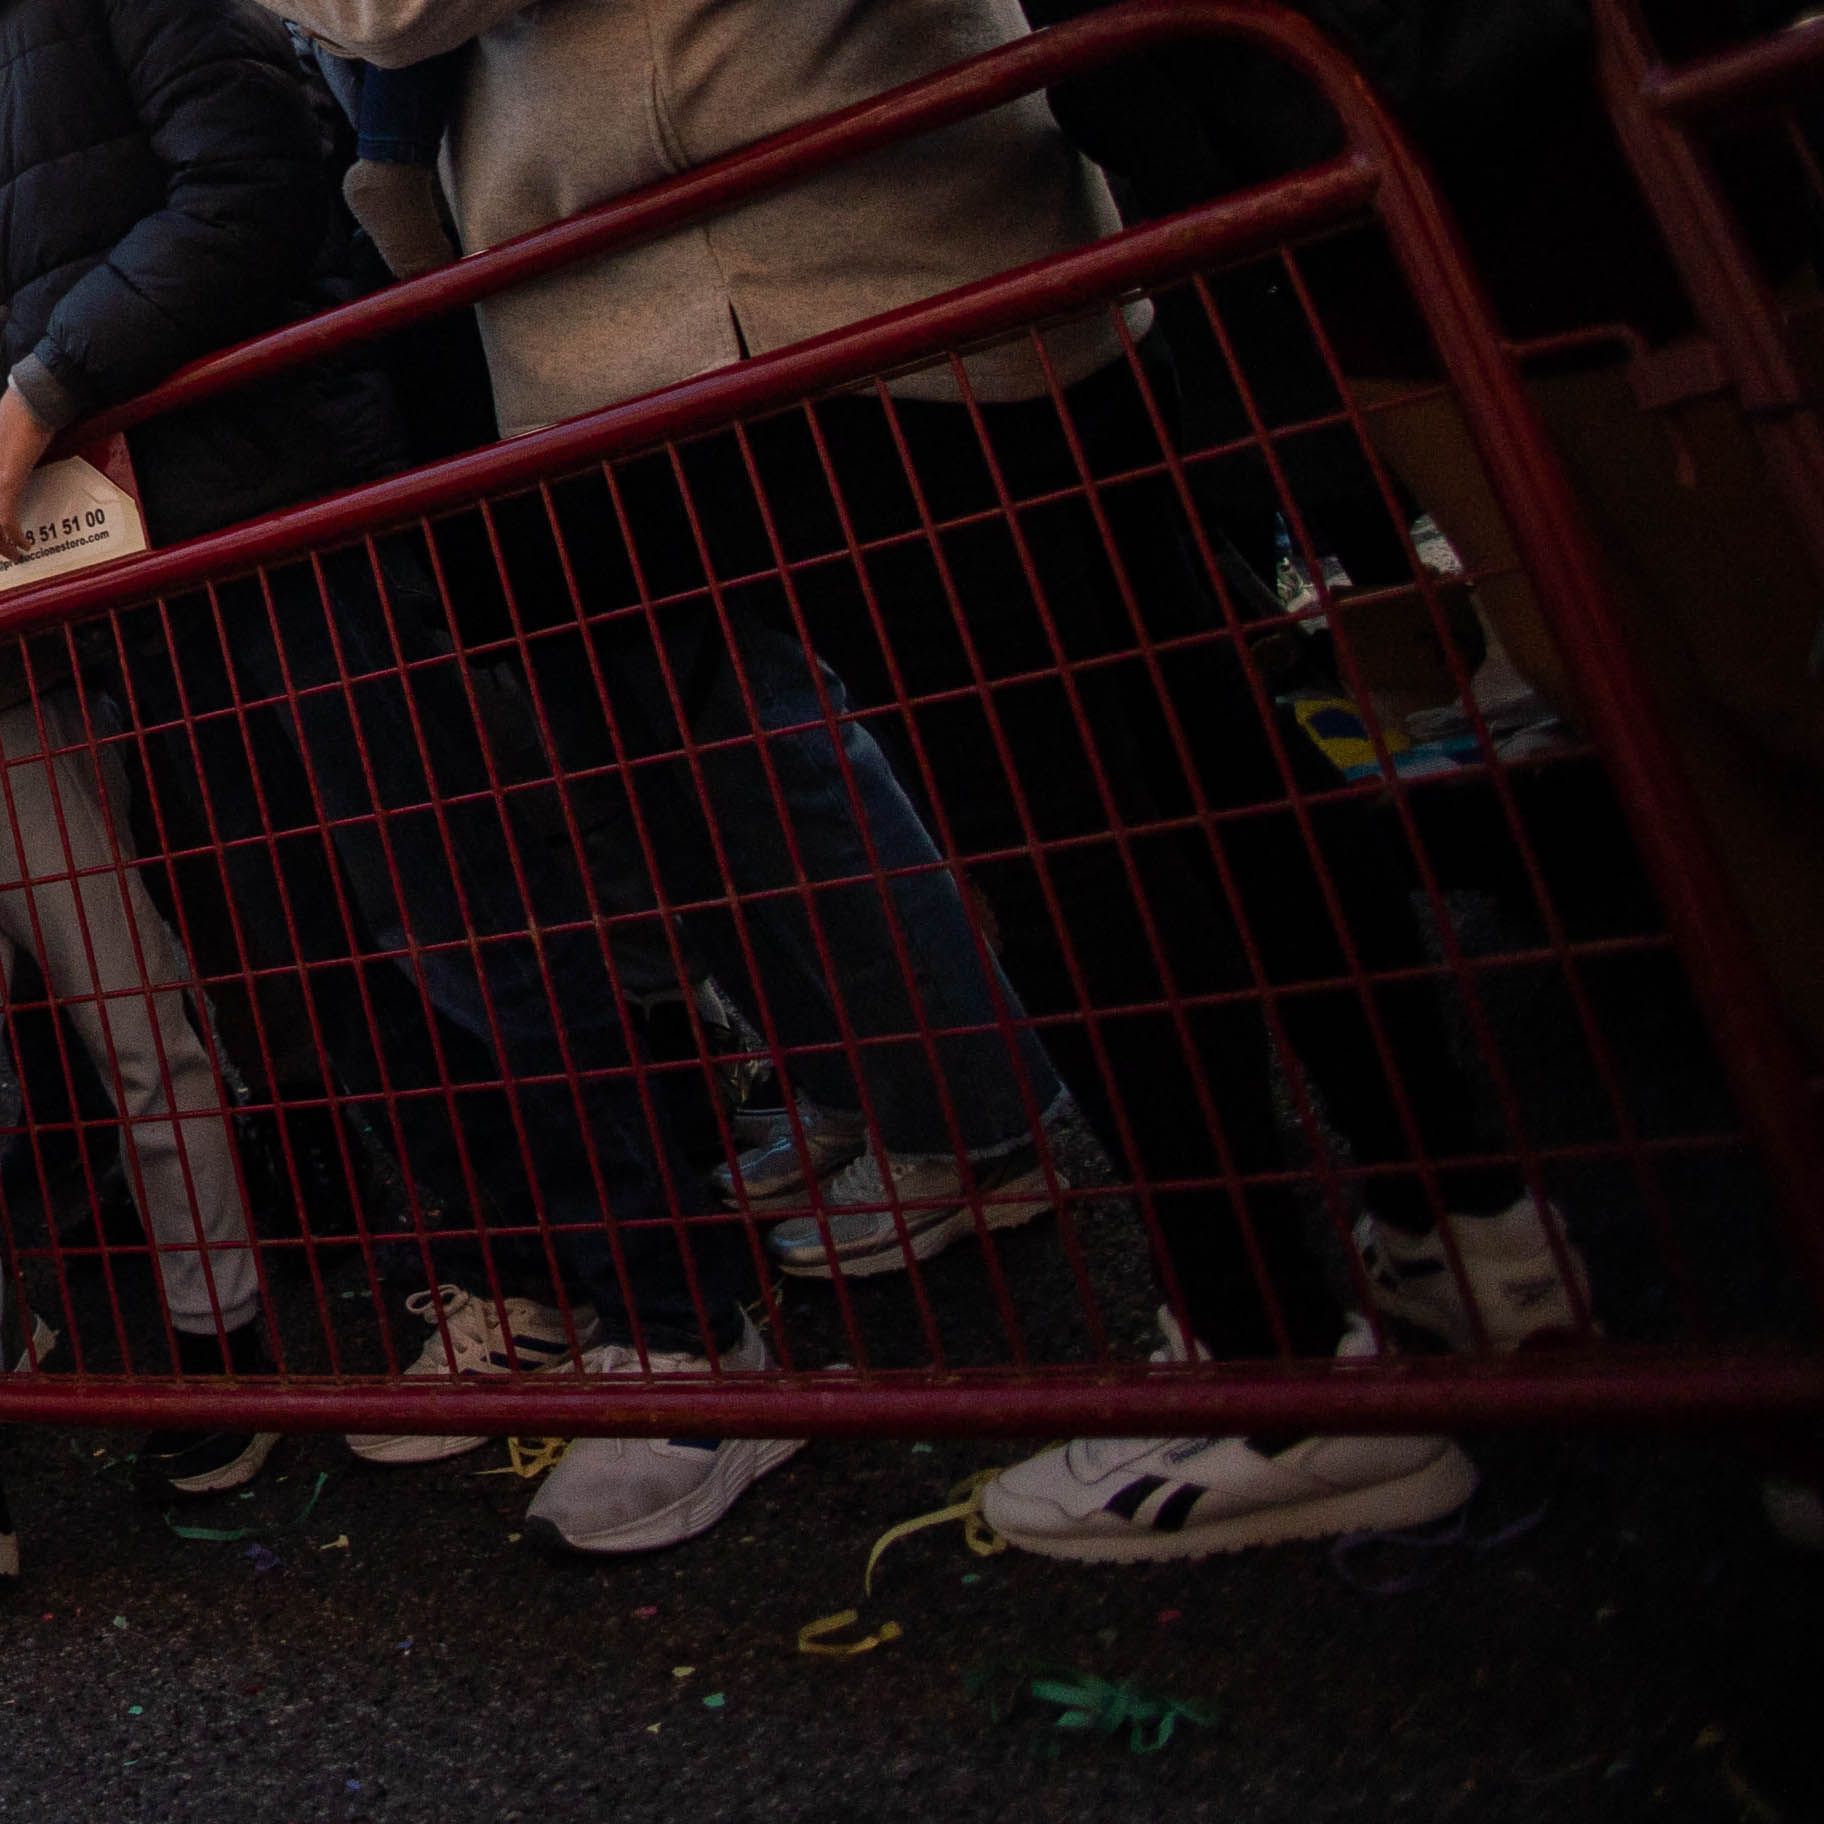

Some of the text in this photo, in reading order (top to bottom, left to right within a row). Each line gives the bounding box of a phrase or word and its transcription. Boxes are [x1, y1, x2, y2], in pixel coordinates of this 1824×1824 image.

[39, 522, 57, 542] 51
[62, 515, 81, 535] 51
[85, 508, 106, 528] 00
